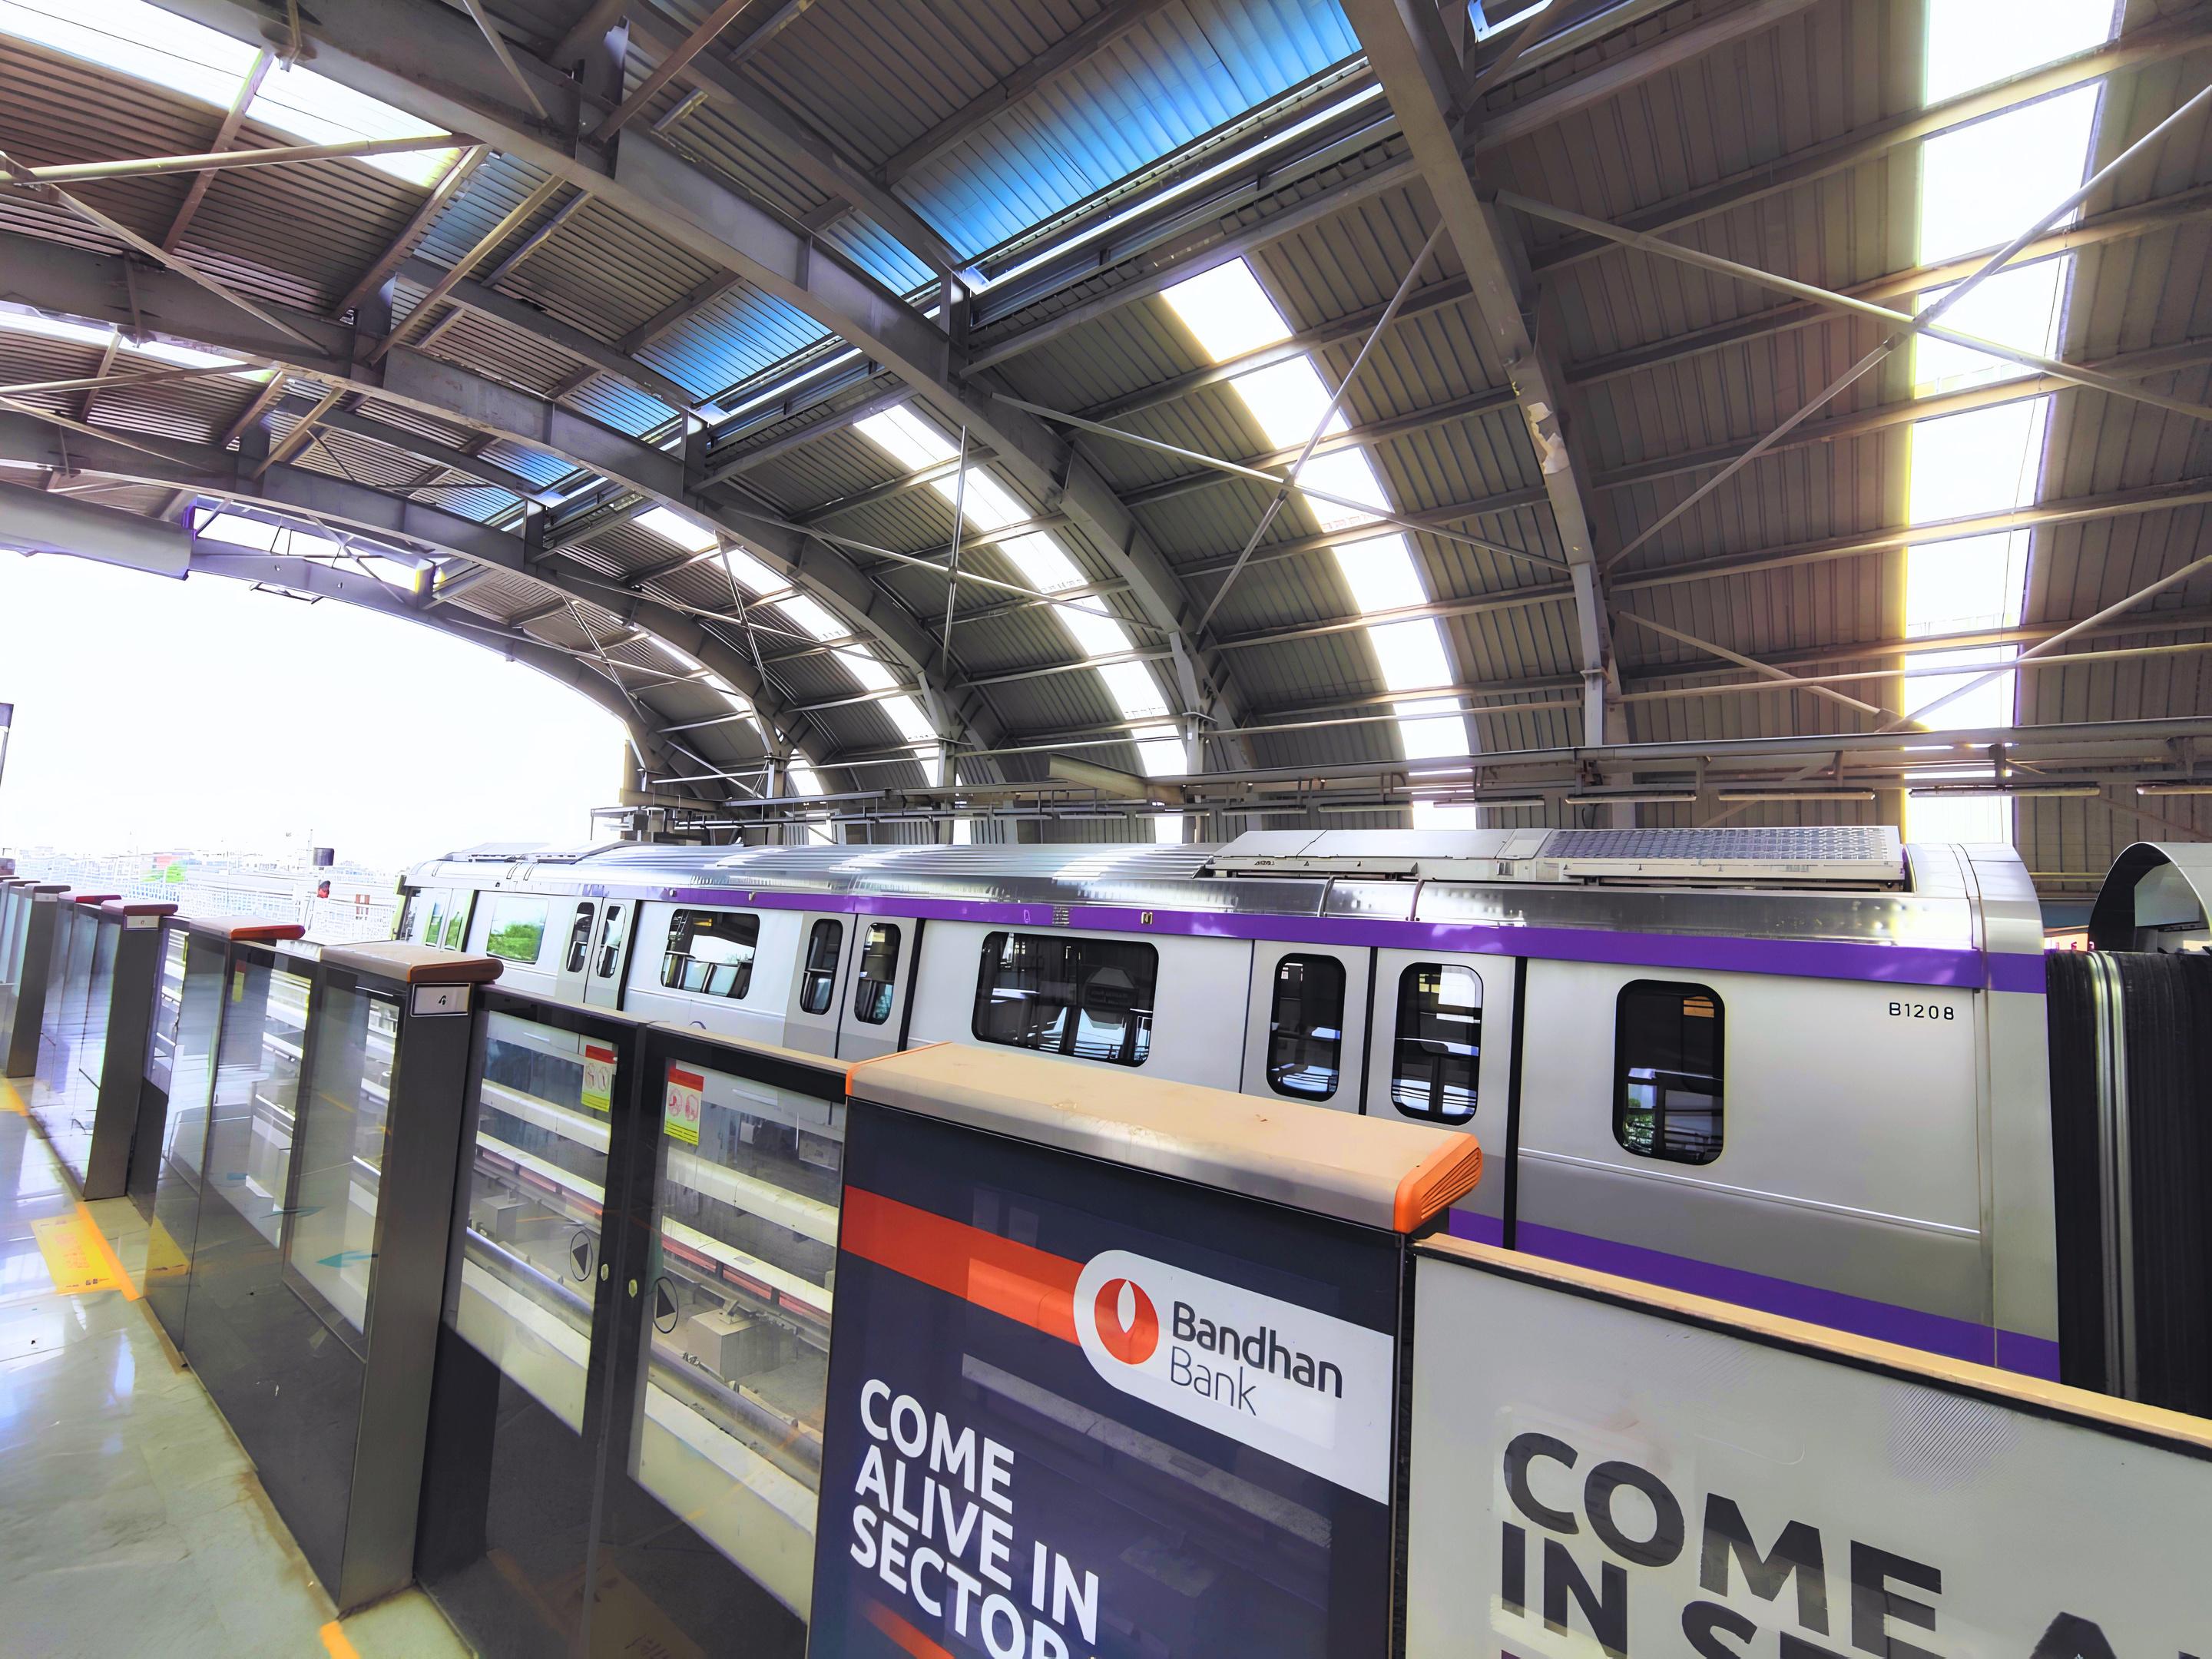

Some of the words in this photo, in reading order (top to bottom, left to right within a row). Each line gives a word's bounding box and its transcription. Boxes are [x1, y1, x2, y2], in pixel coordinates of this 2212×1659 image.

[1889, 1002, 1954, 1021] B1208
[1171, 1345, 1257, 1416] Bank
[1173, 1300, 1343, 1399] Bandhan
[860, 1379, 1015, 1515] COME
[854, 1444, 1014, 1591] ALIVE
[1031, 1540, 1098, 1646] IN
[1502, 1521, 1628, 1659] IN
[1503, 1432, 1946, 1659] COME
